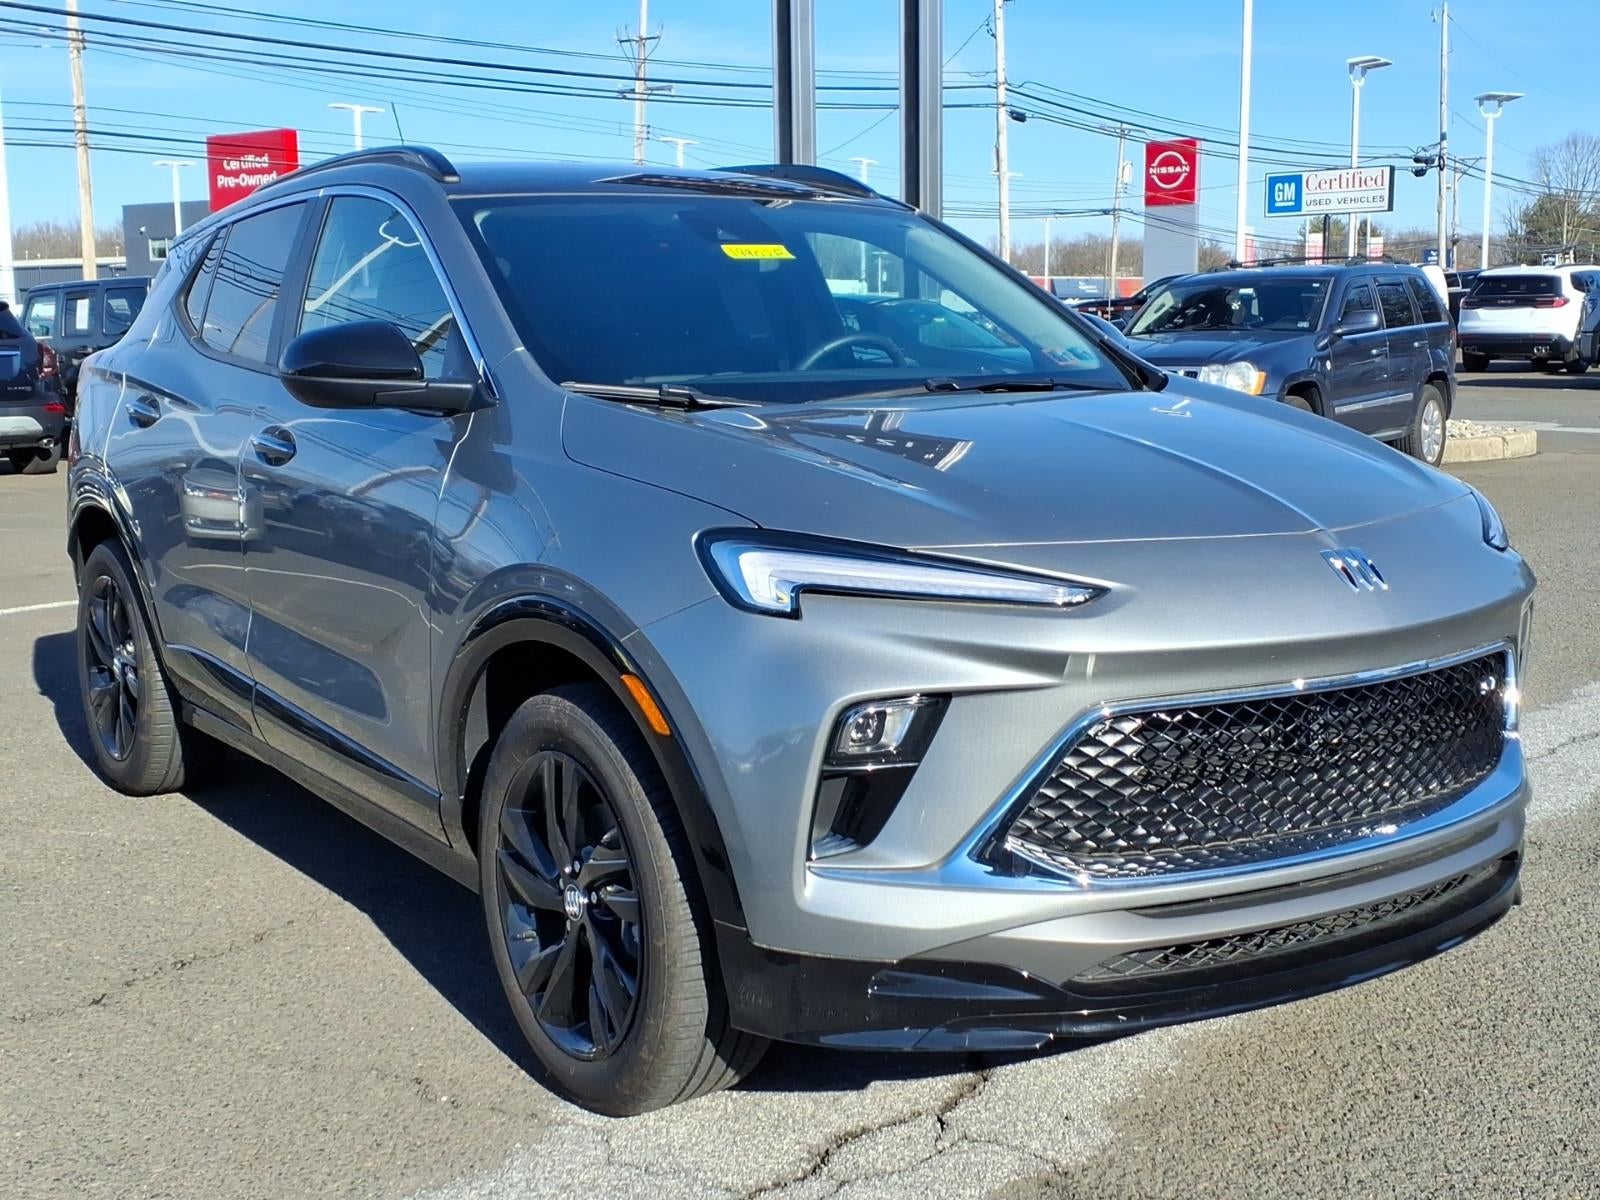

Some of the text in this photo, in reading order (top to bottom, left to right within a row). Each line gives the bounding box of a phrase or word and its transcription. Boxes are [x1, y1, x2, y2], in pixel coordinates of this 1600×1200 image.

[223, 153, 269, 170] Certified
[1149, 164, 1190, 174] NISSAN
[217, 171, 277, 188] Pre-Owned
[1305, 169, 1385, 192] Certified
[1274, 182, 1296, 202] GM
[1305, 194, 1386, 207] USED VEHICLES
